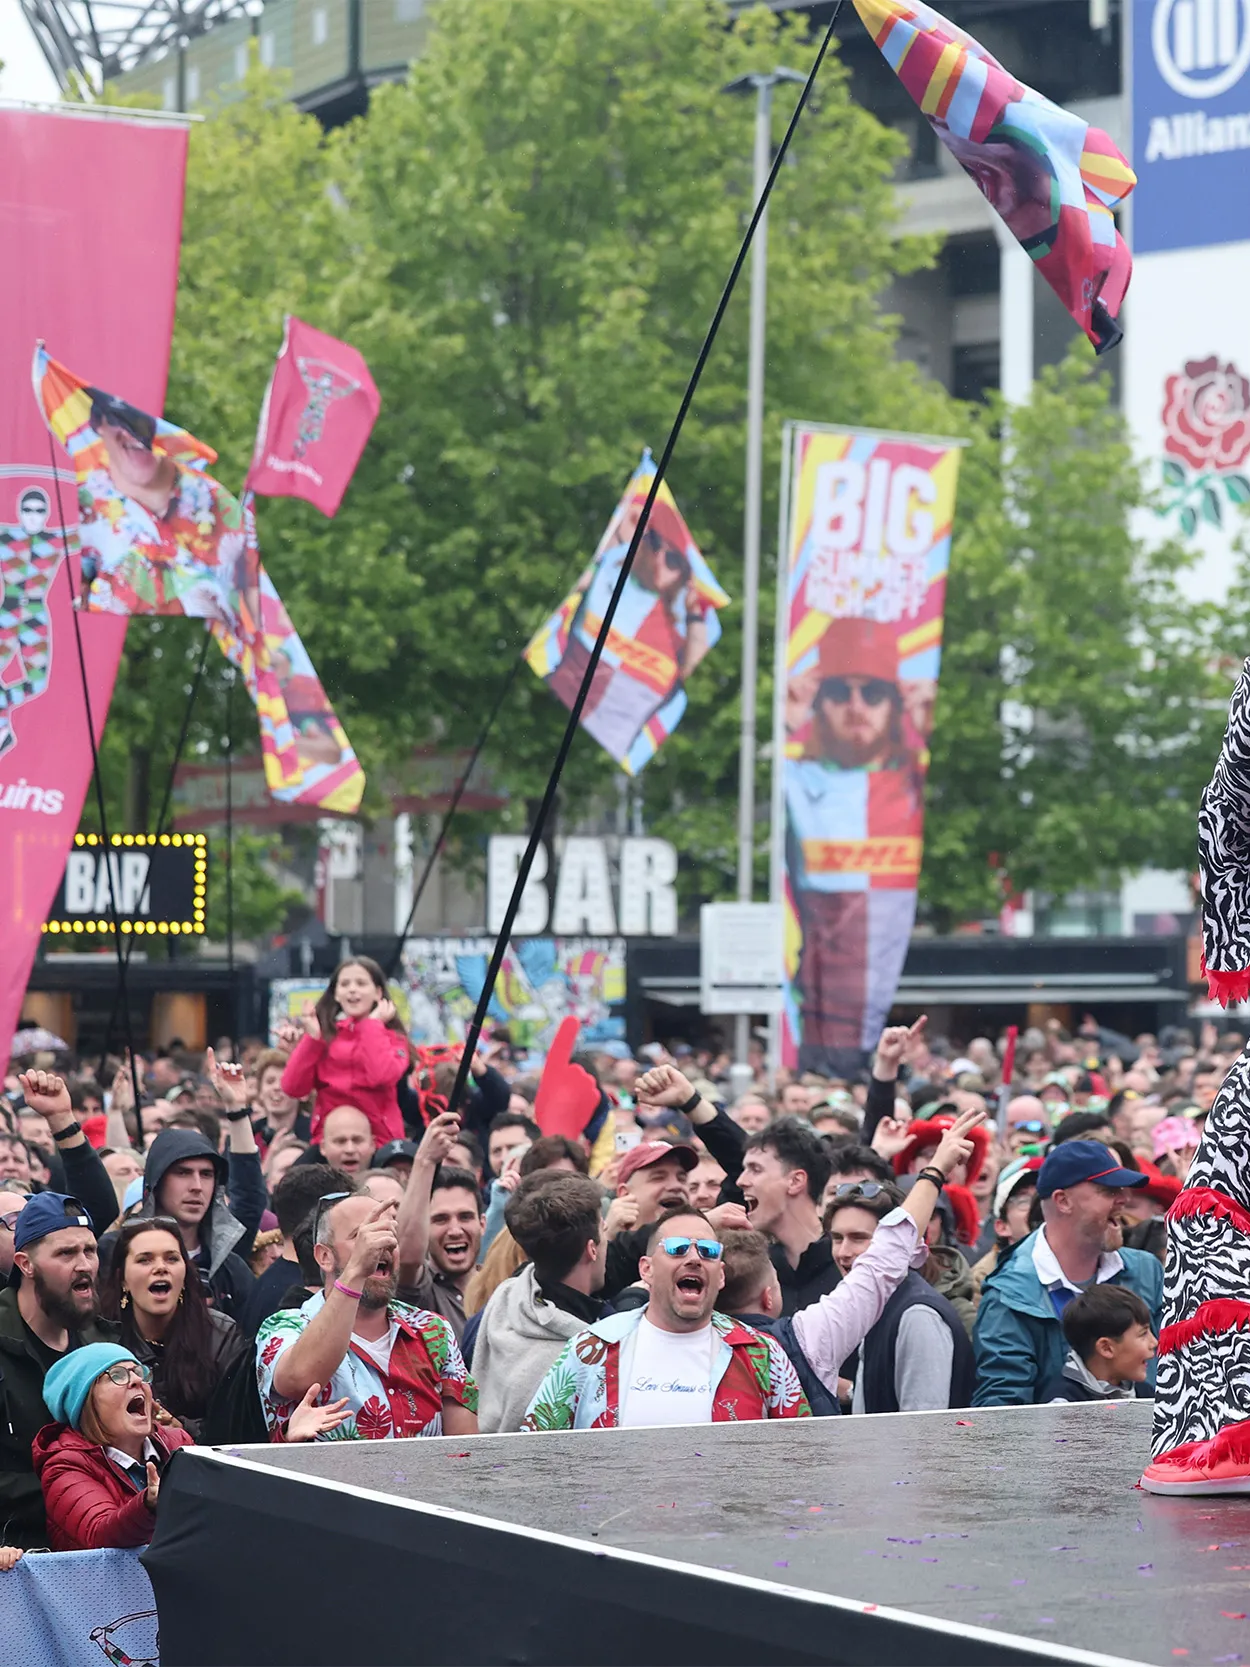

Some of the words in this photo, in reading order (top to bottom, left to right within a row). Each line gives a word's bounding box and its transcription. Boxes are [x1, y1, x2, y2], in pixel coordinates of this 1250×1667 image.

[813, 457, 938, 556] BIG
[65, 851, 150, 915] BAR
[488, 835, 678, 937] BAR
